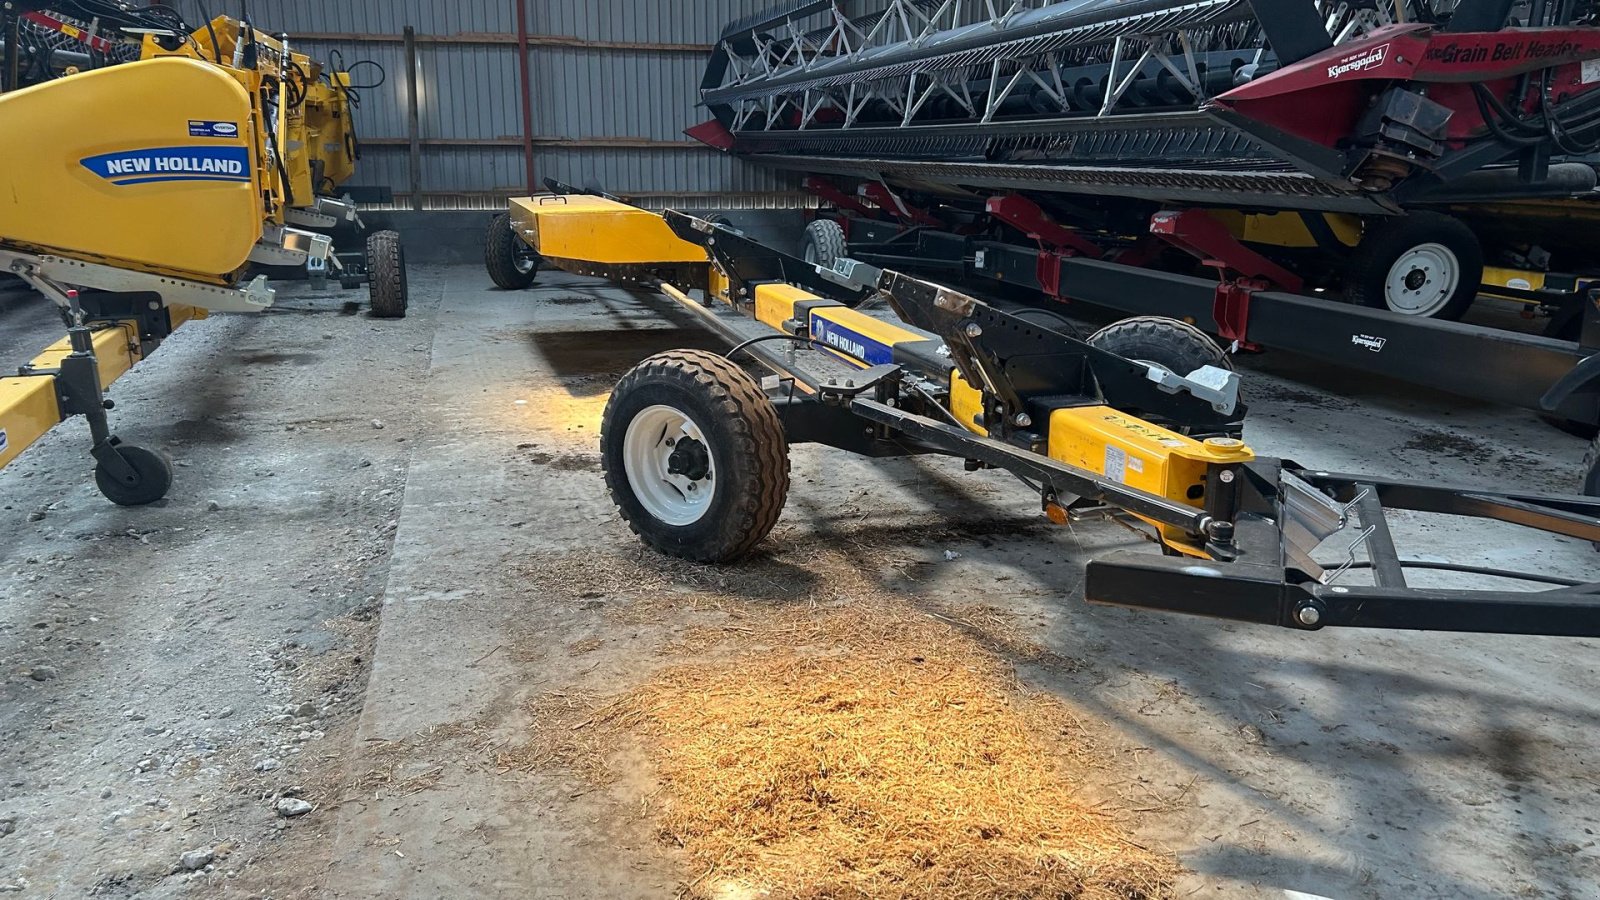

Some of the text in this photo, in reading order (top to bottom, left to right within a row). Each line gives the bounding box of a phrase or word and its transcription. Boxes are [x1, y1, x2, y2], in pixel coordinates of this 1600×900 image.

[1441, 43, 1488, 63] Grain
[1491, 42, 1523, 61] Belt
[1524, 39, 1582, 58] Header
[106, 157, 242, 174] NEW HOLLAND
[826, 329, 865, 359] NEW HOLLAND
